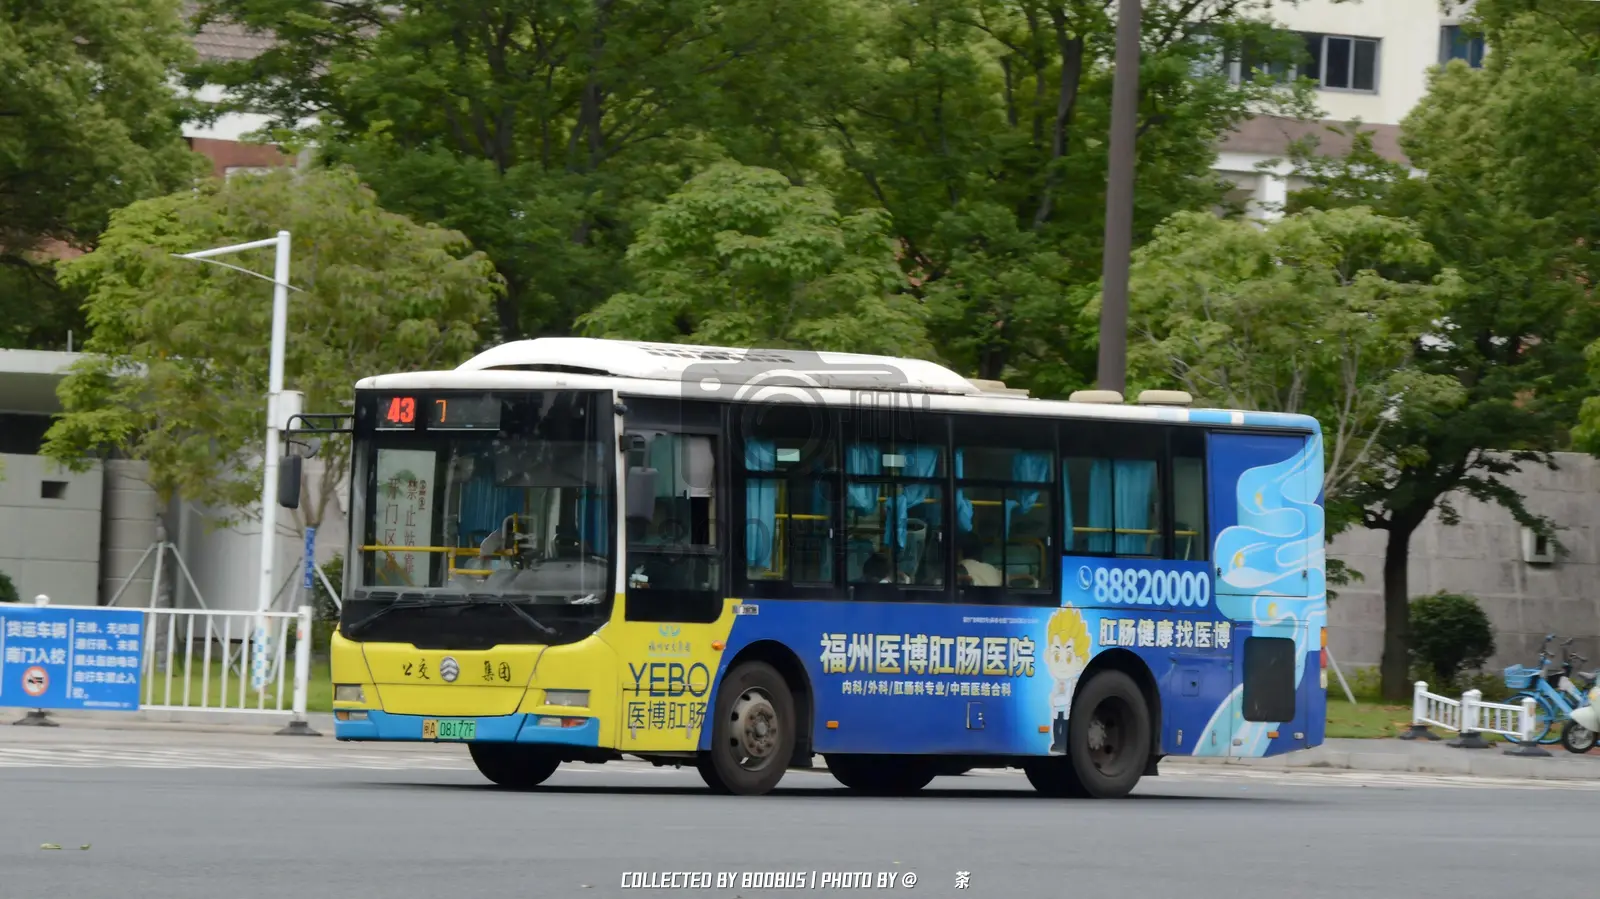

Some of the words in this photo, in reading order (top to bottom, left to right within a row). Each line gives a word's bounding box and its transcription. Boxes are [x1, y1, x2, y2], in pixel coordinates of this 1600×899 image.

[387, 397, 415, 423] 43
[1094, 567, 1210, 607] 88820000
[7, 620, 67, 639] 货运车辆
[1098, 618, 1231, 649] 肛肠健康找医博
[5, 646, 66, 664] 南门入校
[820, 632, 1035, 677] 福州医博肛肠医院
[402, 658, 430, 680] 公交
[481, 660, 511, 682] 集团
[628, 662, 710, 698] YEBO
[842, 680, 1011, 697] 内科/外科/肛肠科专业/中西医结合科
[627, 700, 708, 731] 医博肛肠
